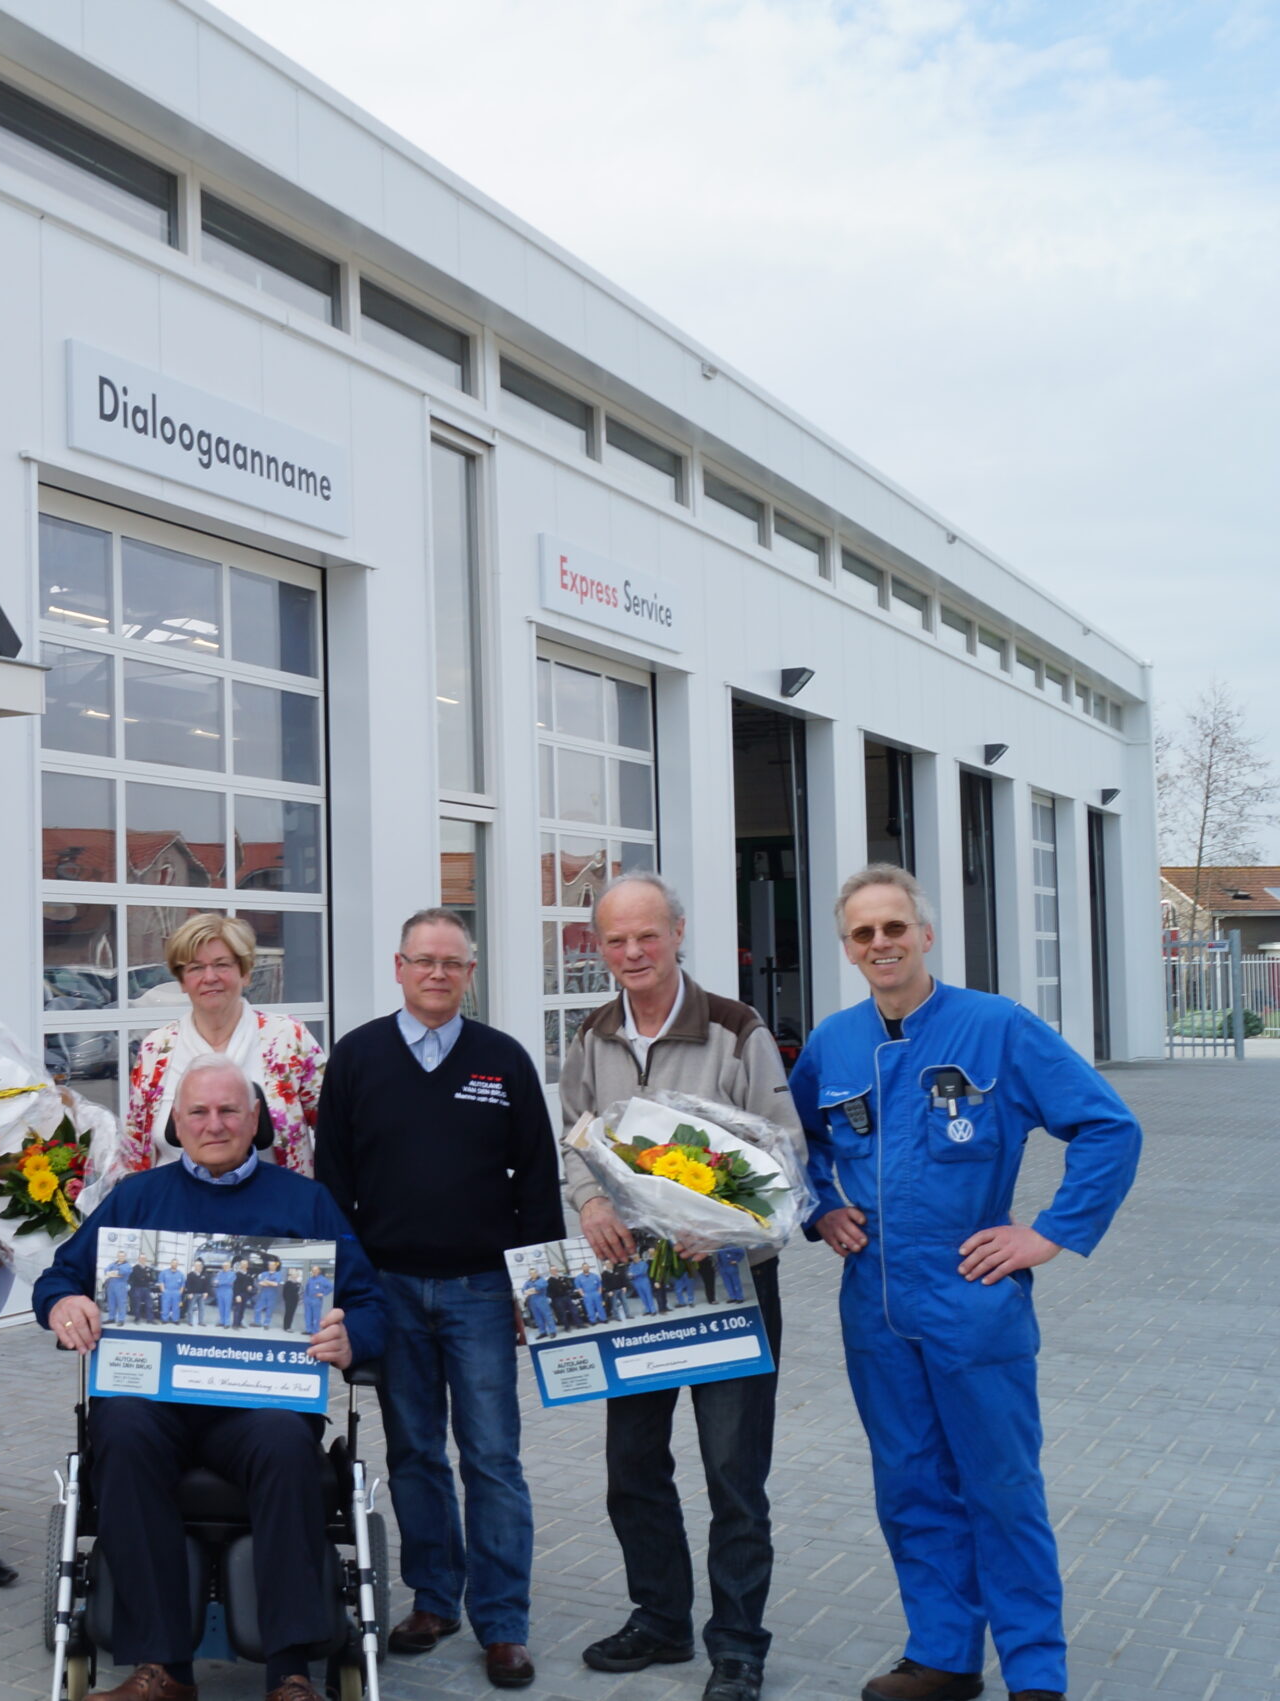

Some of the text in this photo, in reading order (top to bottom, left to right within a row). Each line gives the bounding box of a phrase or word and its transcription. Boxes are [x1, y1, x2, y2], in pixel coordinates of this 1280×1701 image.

[98, 375, 332, 501] Dialooganname
[560, 554, 673, 628] Express Service
[176, 1343, 264, 1362] Waardecheque
[277, 1351, 286, 1363] €
[611, 1327, 697, 1349] Waardecheque
[709, 1320, 719, 1332] €
